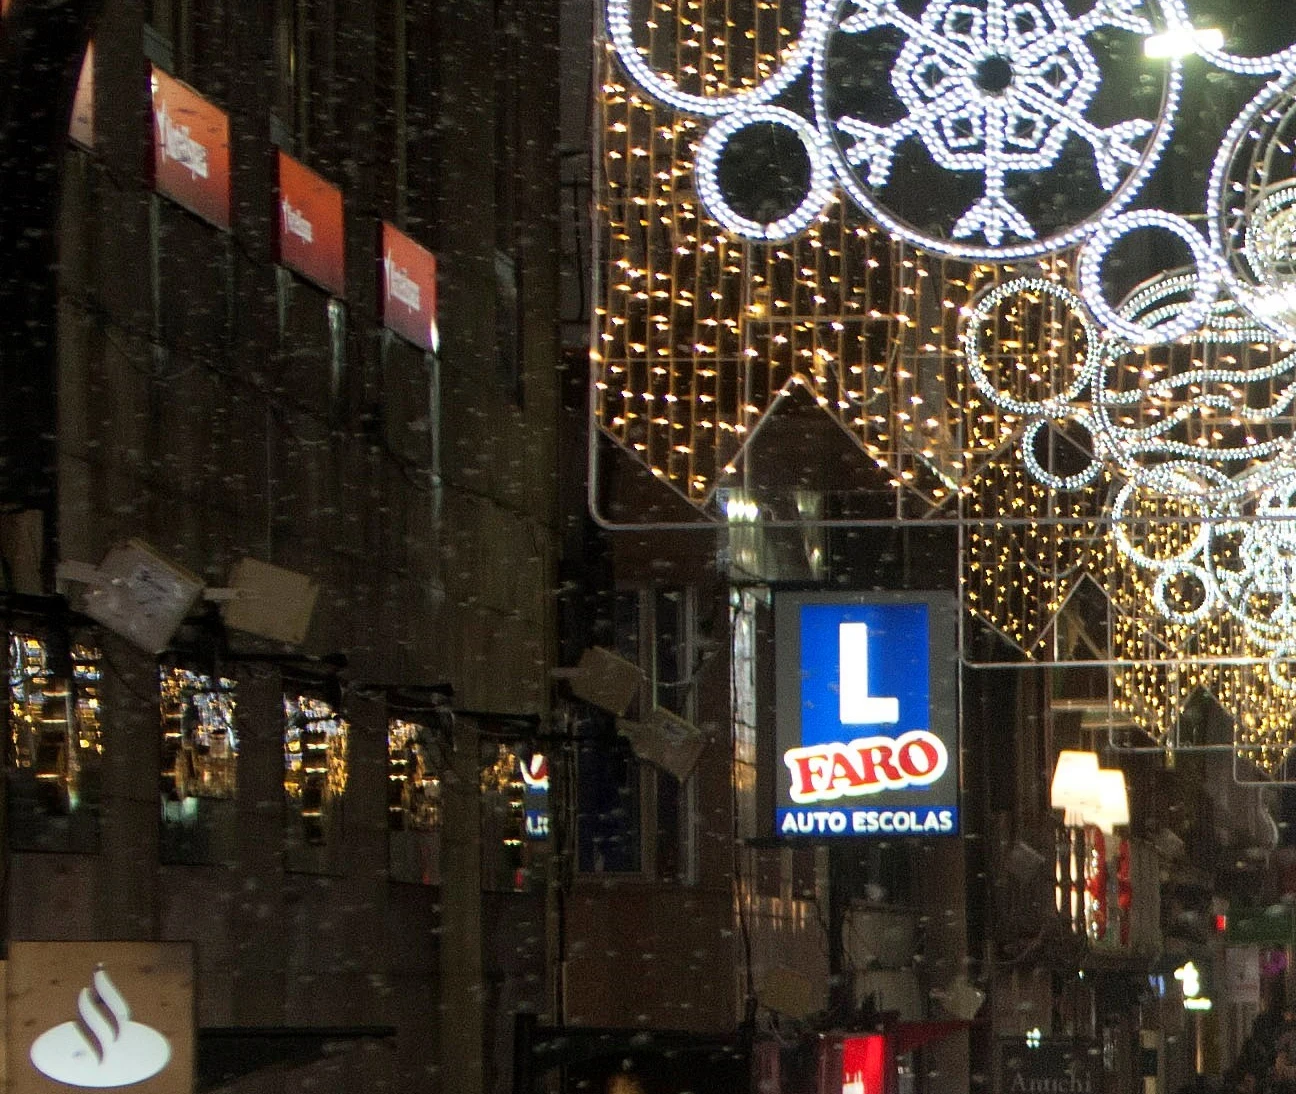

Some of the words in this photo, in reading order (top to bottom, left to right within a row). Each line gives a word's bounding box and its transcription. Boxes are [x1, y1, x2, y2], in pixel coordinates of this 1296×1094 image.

[839, 622, 899, 725] L
[794, 738, 940, 795] FARO
[781, 811, 848, 833] AUTO
[852, 810, 953, 832] ESCOLAS
